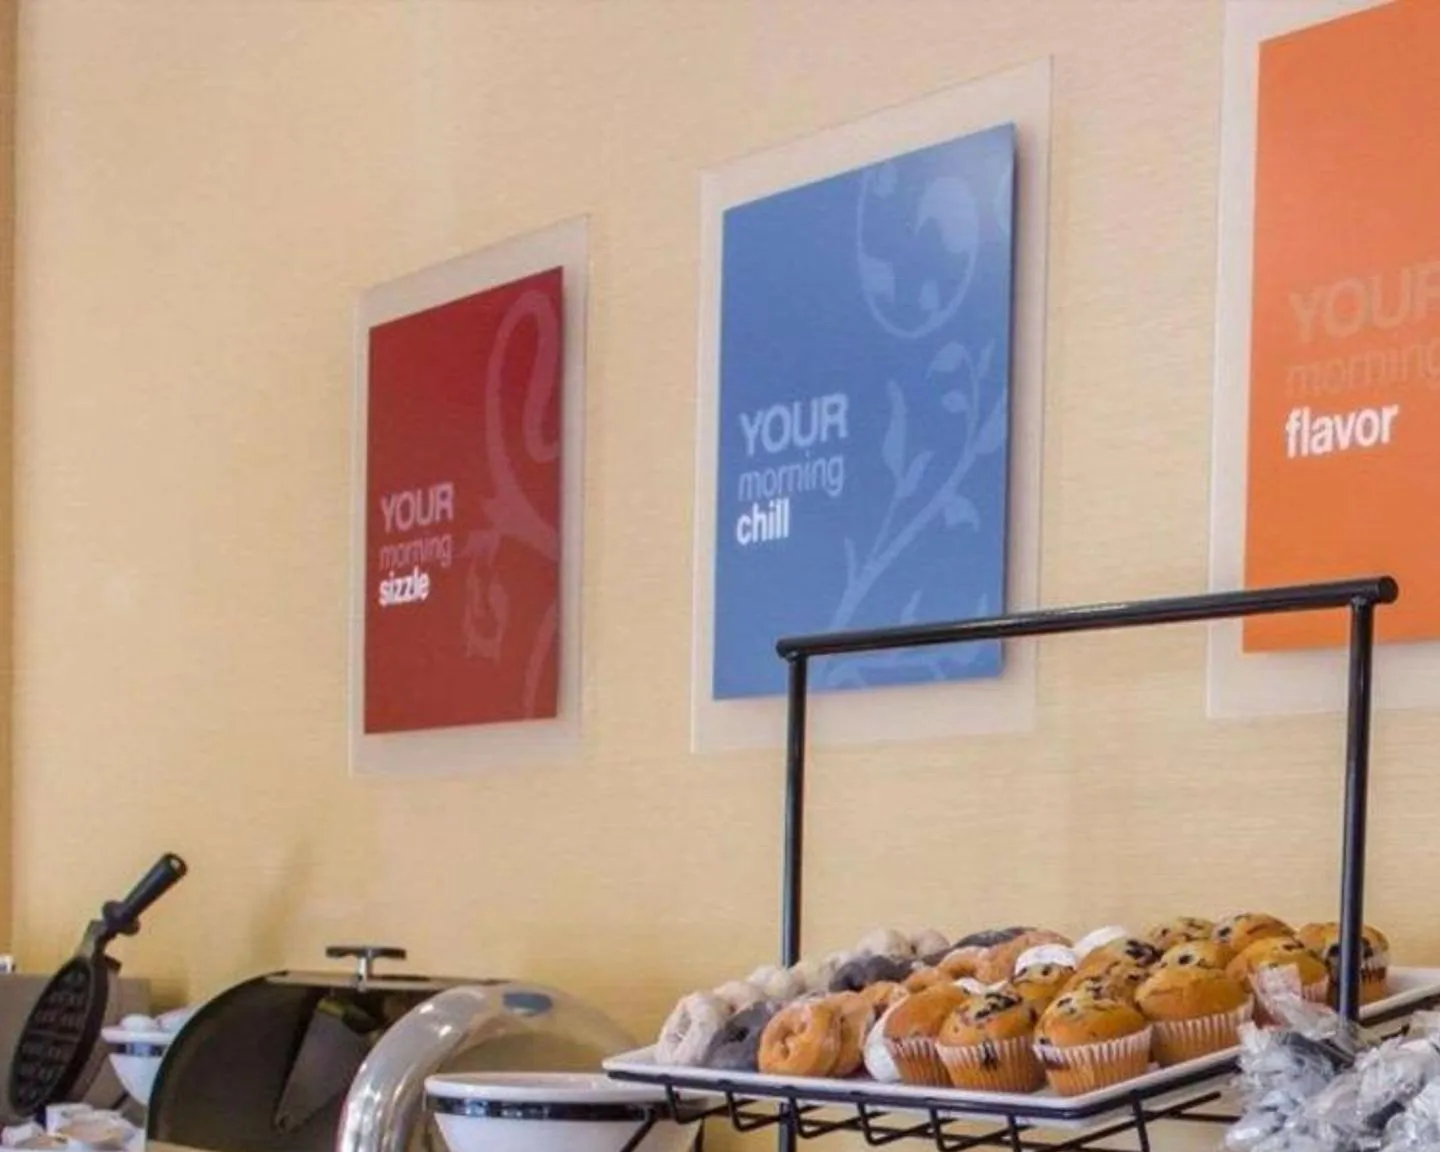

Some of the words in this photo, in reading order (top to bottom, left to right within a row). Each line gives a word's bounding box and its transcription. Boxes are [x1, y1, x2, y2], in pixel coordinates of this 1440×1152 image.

[738, 392, 849, 457] YOUR
[1285, 403, 1400, 459] flavor
[737, 448, 845, 501] morning
[379, 481, 455, 533] YOUR
[736, 498, 791, 546] chill
[378, 532, 453, 571] morning
[378, 565, 431, 607] sizzle
